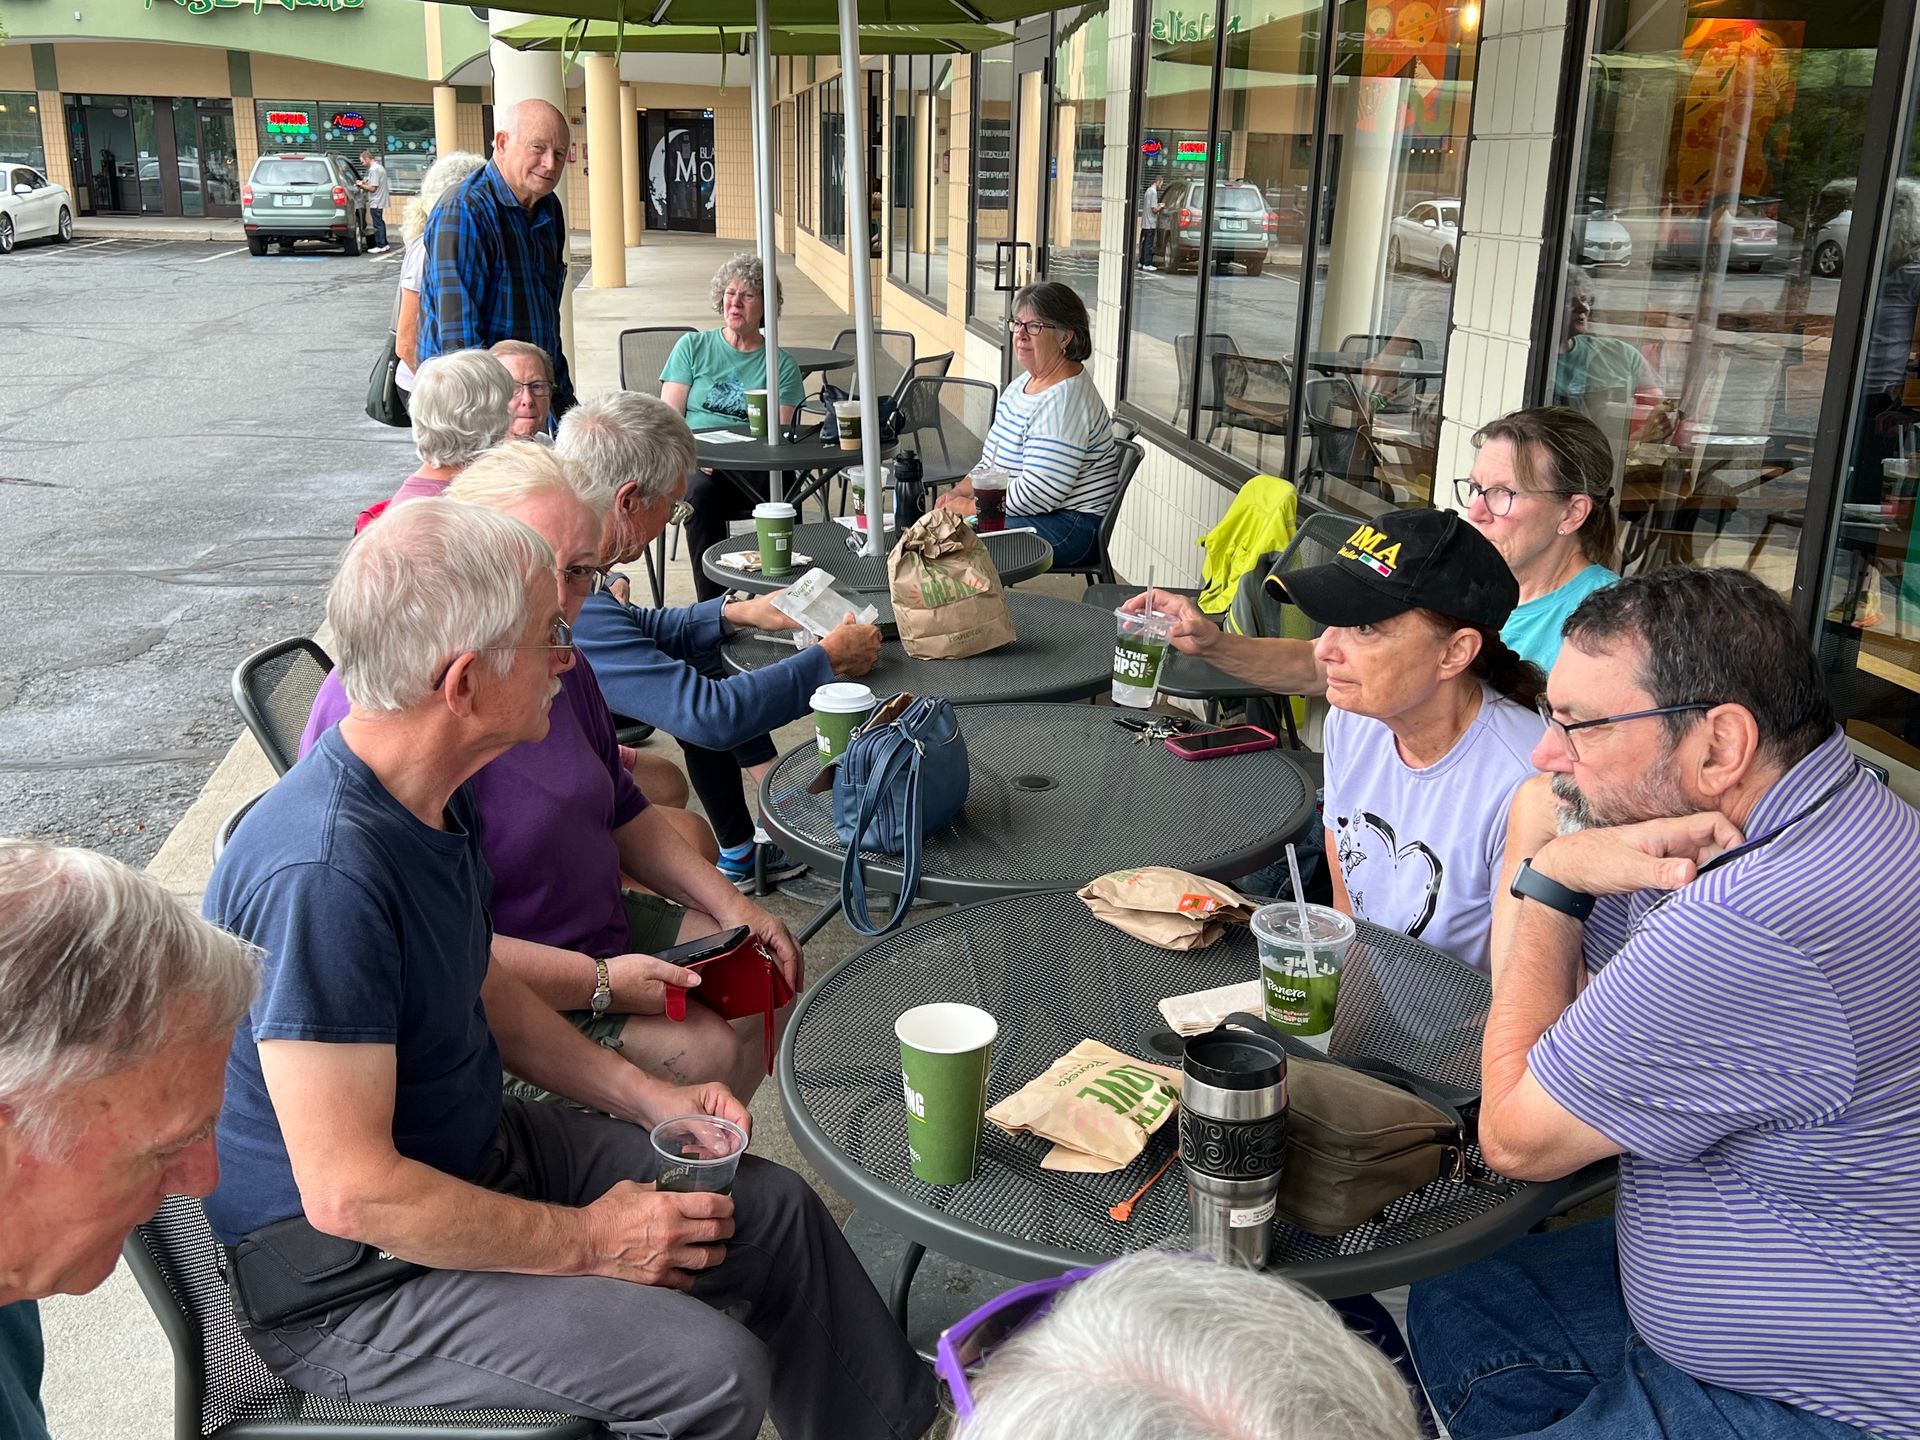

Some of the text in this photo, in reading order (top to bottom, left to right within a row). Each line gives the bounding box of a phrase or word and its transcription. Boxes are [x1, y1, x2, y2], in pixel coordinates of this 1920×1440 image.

[333, 114, 364, 128] Nails
[1125, 650, 1149, 662] THE
[1265, 976, 1306, 998] Panera
